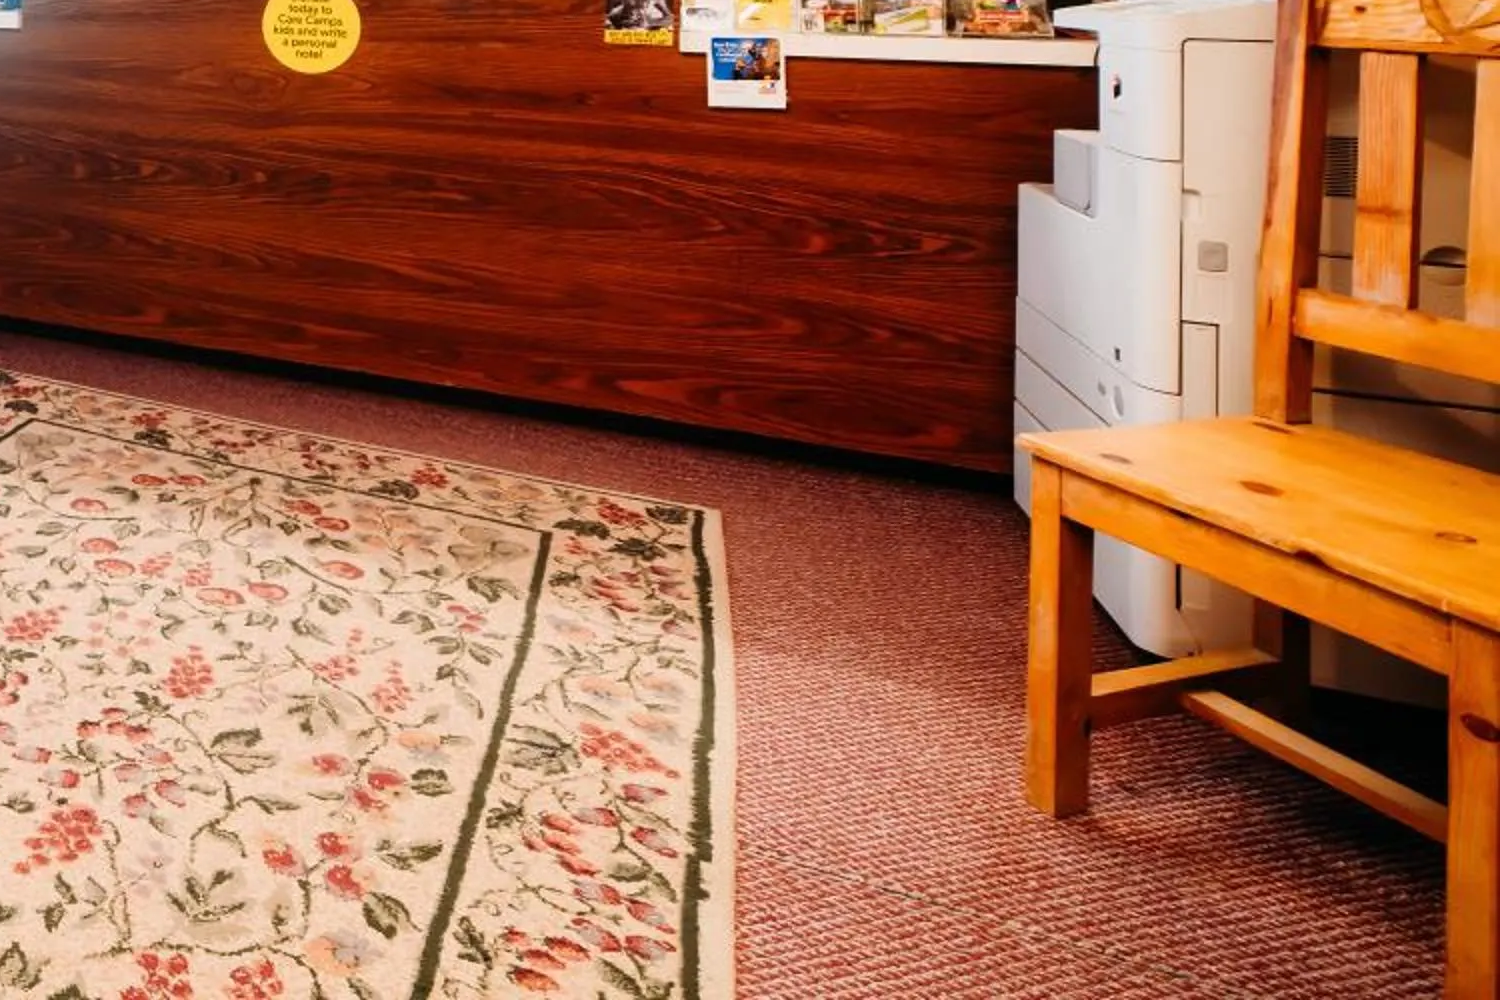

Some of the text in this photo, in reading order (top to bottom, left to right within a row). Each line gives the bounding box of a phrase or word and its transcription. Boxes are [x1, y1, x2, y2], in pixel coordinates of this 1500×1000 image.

[288, 3, 333, 16] today to
[273, 24, 348, 39] kids and write
[291, 38, 337, 49] personal
